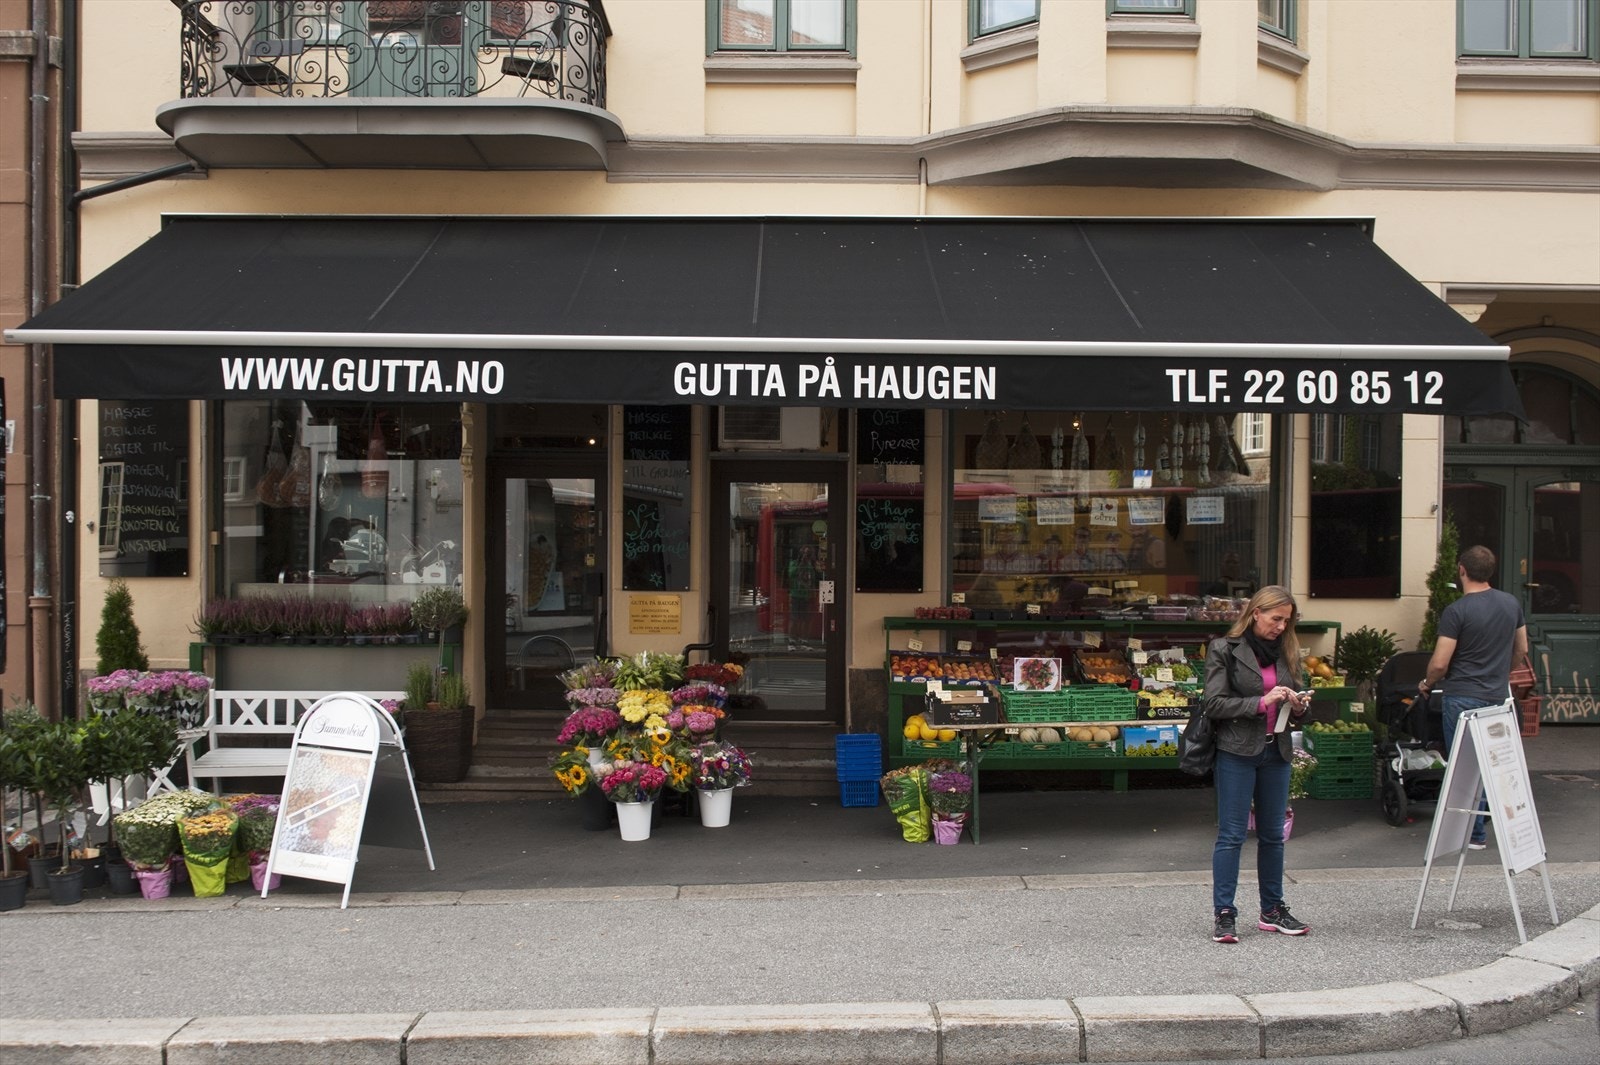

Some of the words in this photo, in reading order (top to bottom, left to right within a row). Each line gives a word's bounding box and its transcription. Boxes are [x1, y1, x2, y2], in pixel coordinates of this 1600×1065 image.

[221, 357, 505, 394] WWW.GUTTA.NO
[673, 362, 787, 398] GUTTA
[799, 356, 842, 398] PÅ
[854, 365, 996, 400] HAUGEN
[1165, 369, 1231, 403] TLF.
[1243, 369, 1285, 403] 22
[1296, 370, 1338, 404] 60
[1350, 370, 1392, 405] 85
[1403, 370, 1444, 405] 12
[104, 406, 153, 421] MASSE
[872, 409, 905, 426] OST
[105, 441, 145, 456] OSTER
[627, 503, 665, 528] Vi
[858, 498, 880, 521] Vi
[880, 499, 914, 518] har
[1157, 708, 1182, 717] GMS
[311, 714, 368, 738] Summerbird
